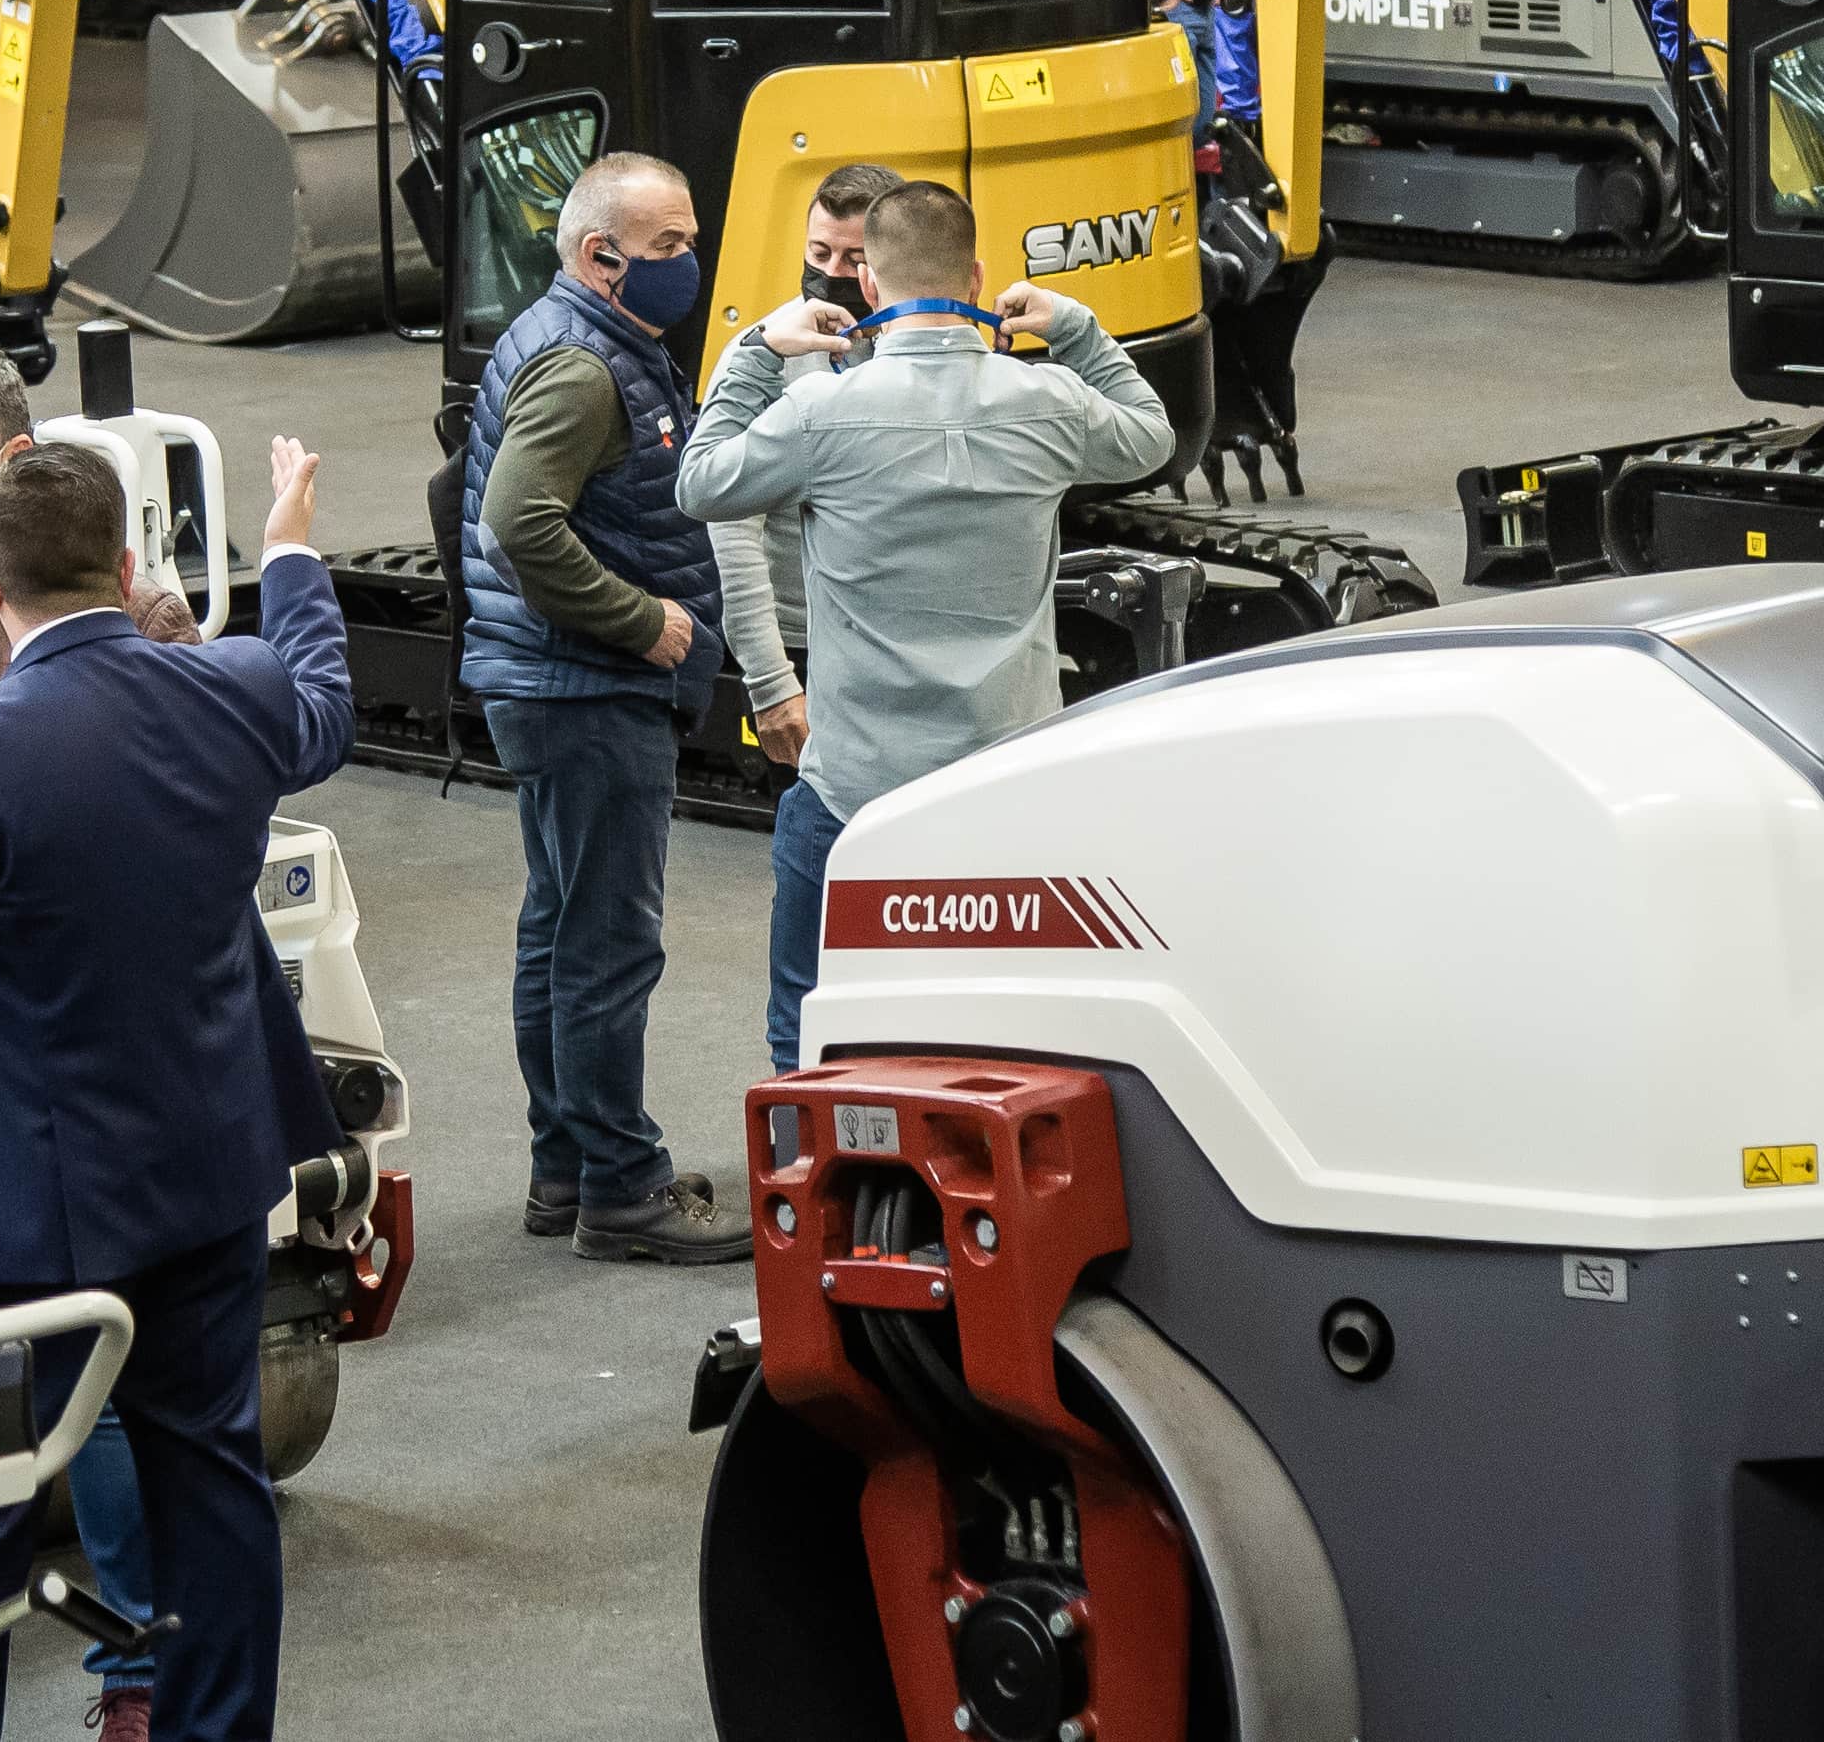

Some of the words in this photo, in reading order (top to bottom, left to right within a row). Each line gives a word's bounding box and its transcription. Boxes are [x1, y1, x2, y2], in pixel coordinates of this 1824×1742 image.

[1022, 205, 1160, 279] SANY
[882, 893, 999, 933] CC1400
[1007, 893, 1041, 932] VI
